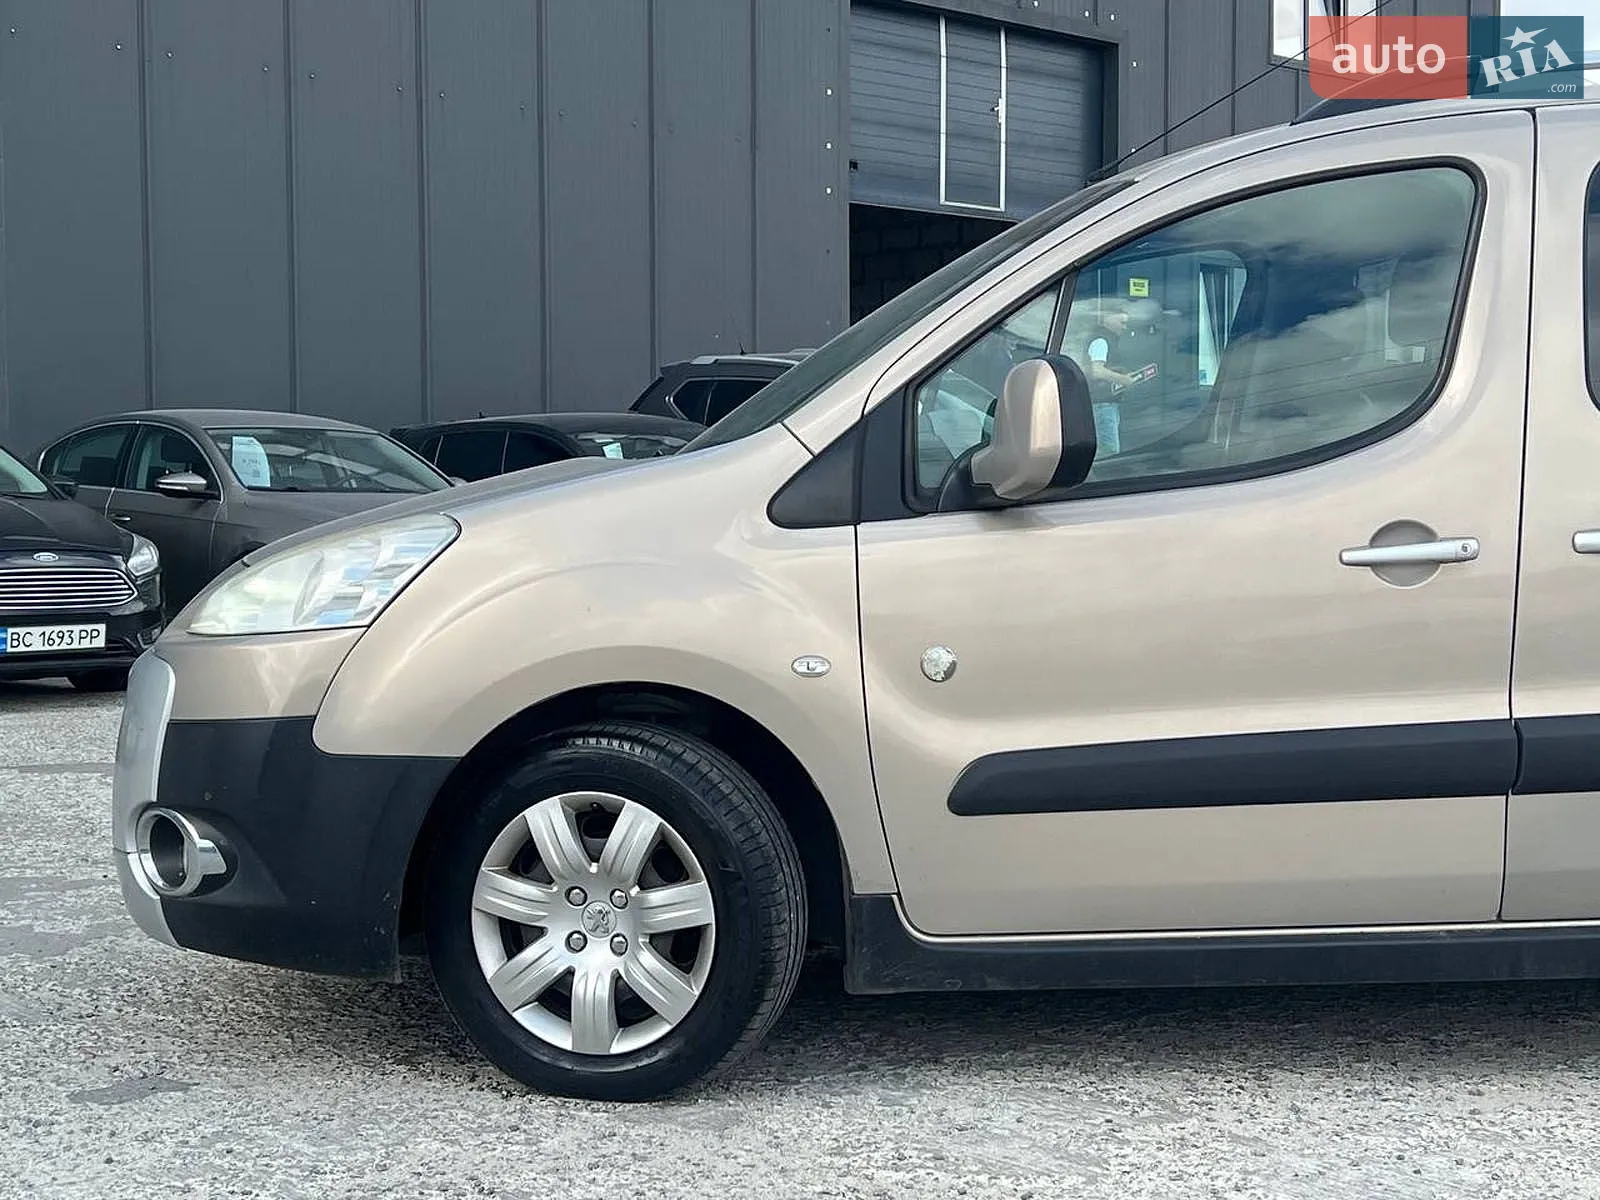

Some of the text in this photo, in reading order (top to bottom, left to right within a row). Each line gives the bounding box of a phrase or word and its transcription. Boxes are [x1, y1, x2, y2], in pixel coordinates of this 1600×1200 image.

[10, 629, 100, 648] BC 1693 PP
